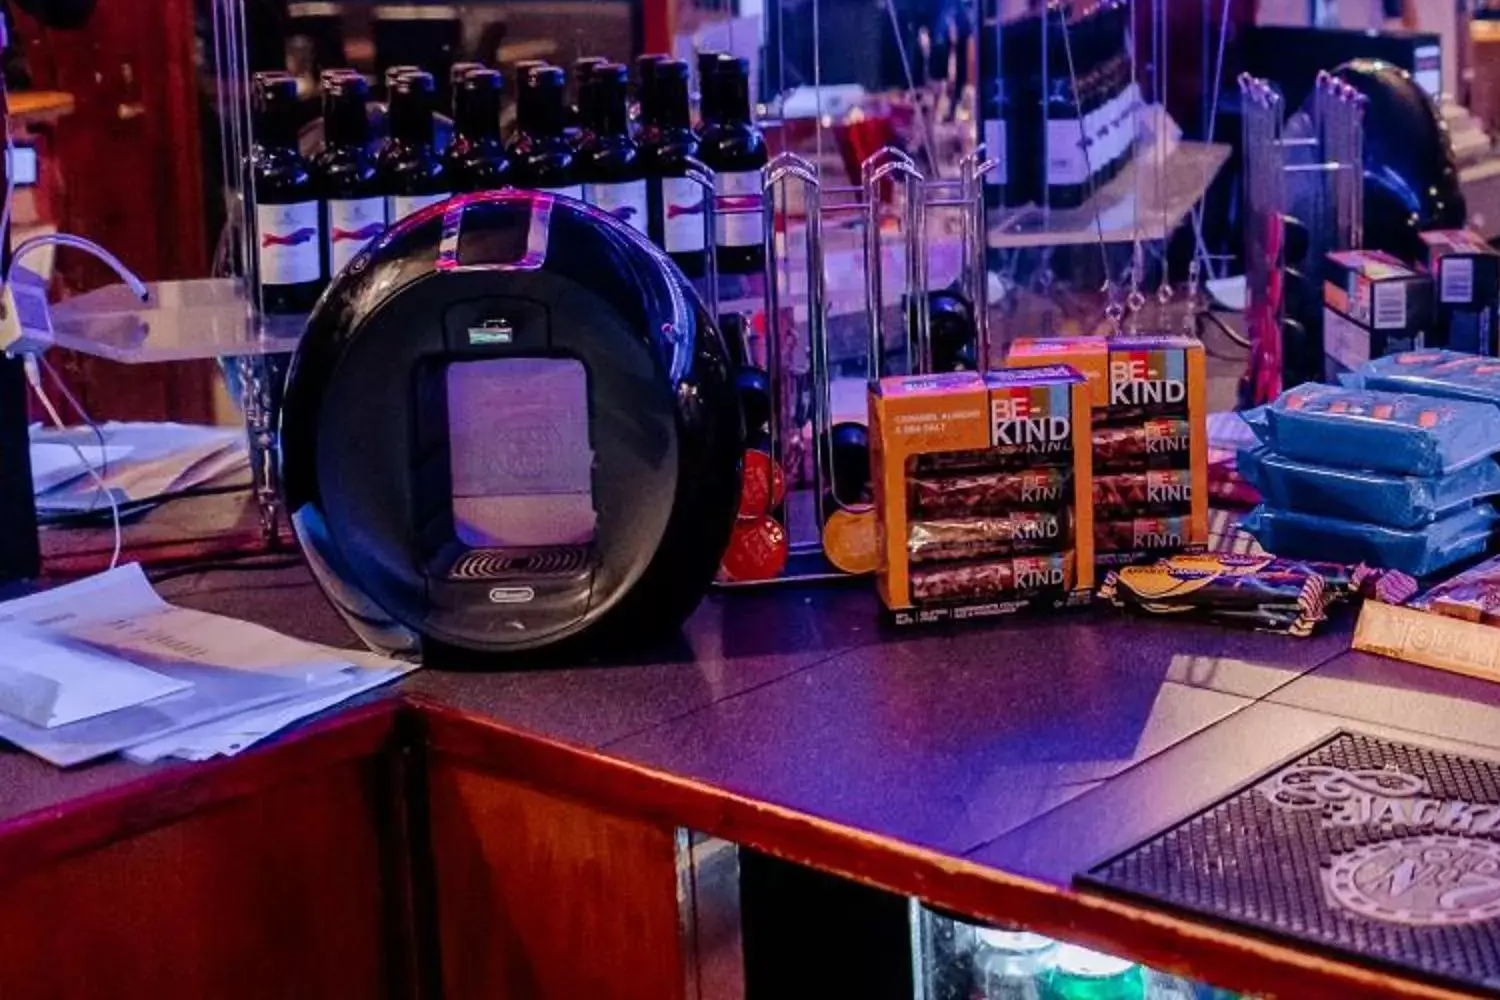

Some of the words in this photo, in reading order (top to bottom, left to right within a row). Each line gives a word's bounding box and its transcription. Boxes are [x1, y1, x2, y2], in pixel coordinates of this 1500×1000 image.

[1110, 359, 1158, 382] BE-
[1111, 379, 1186, 405] KIND
[990, 398, 1042, 421] BE-
[991, 416, 1071, 447] KIND
[1013, 568, 1064, 589] KIND
[1333, 795, 1479, 830] JACK
